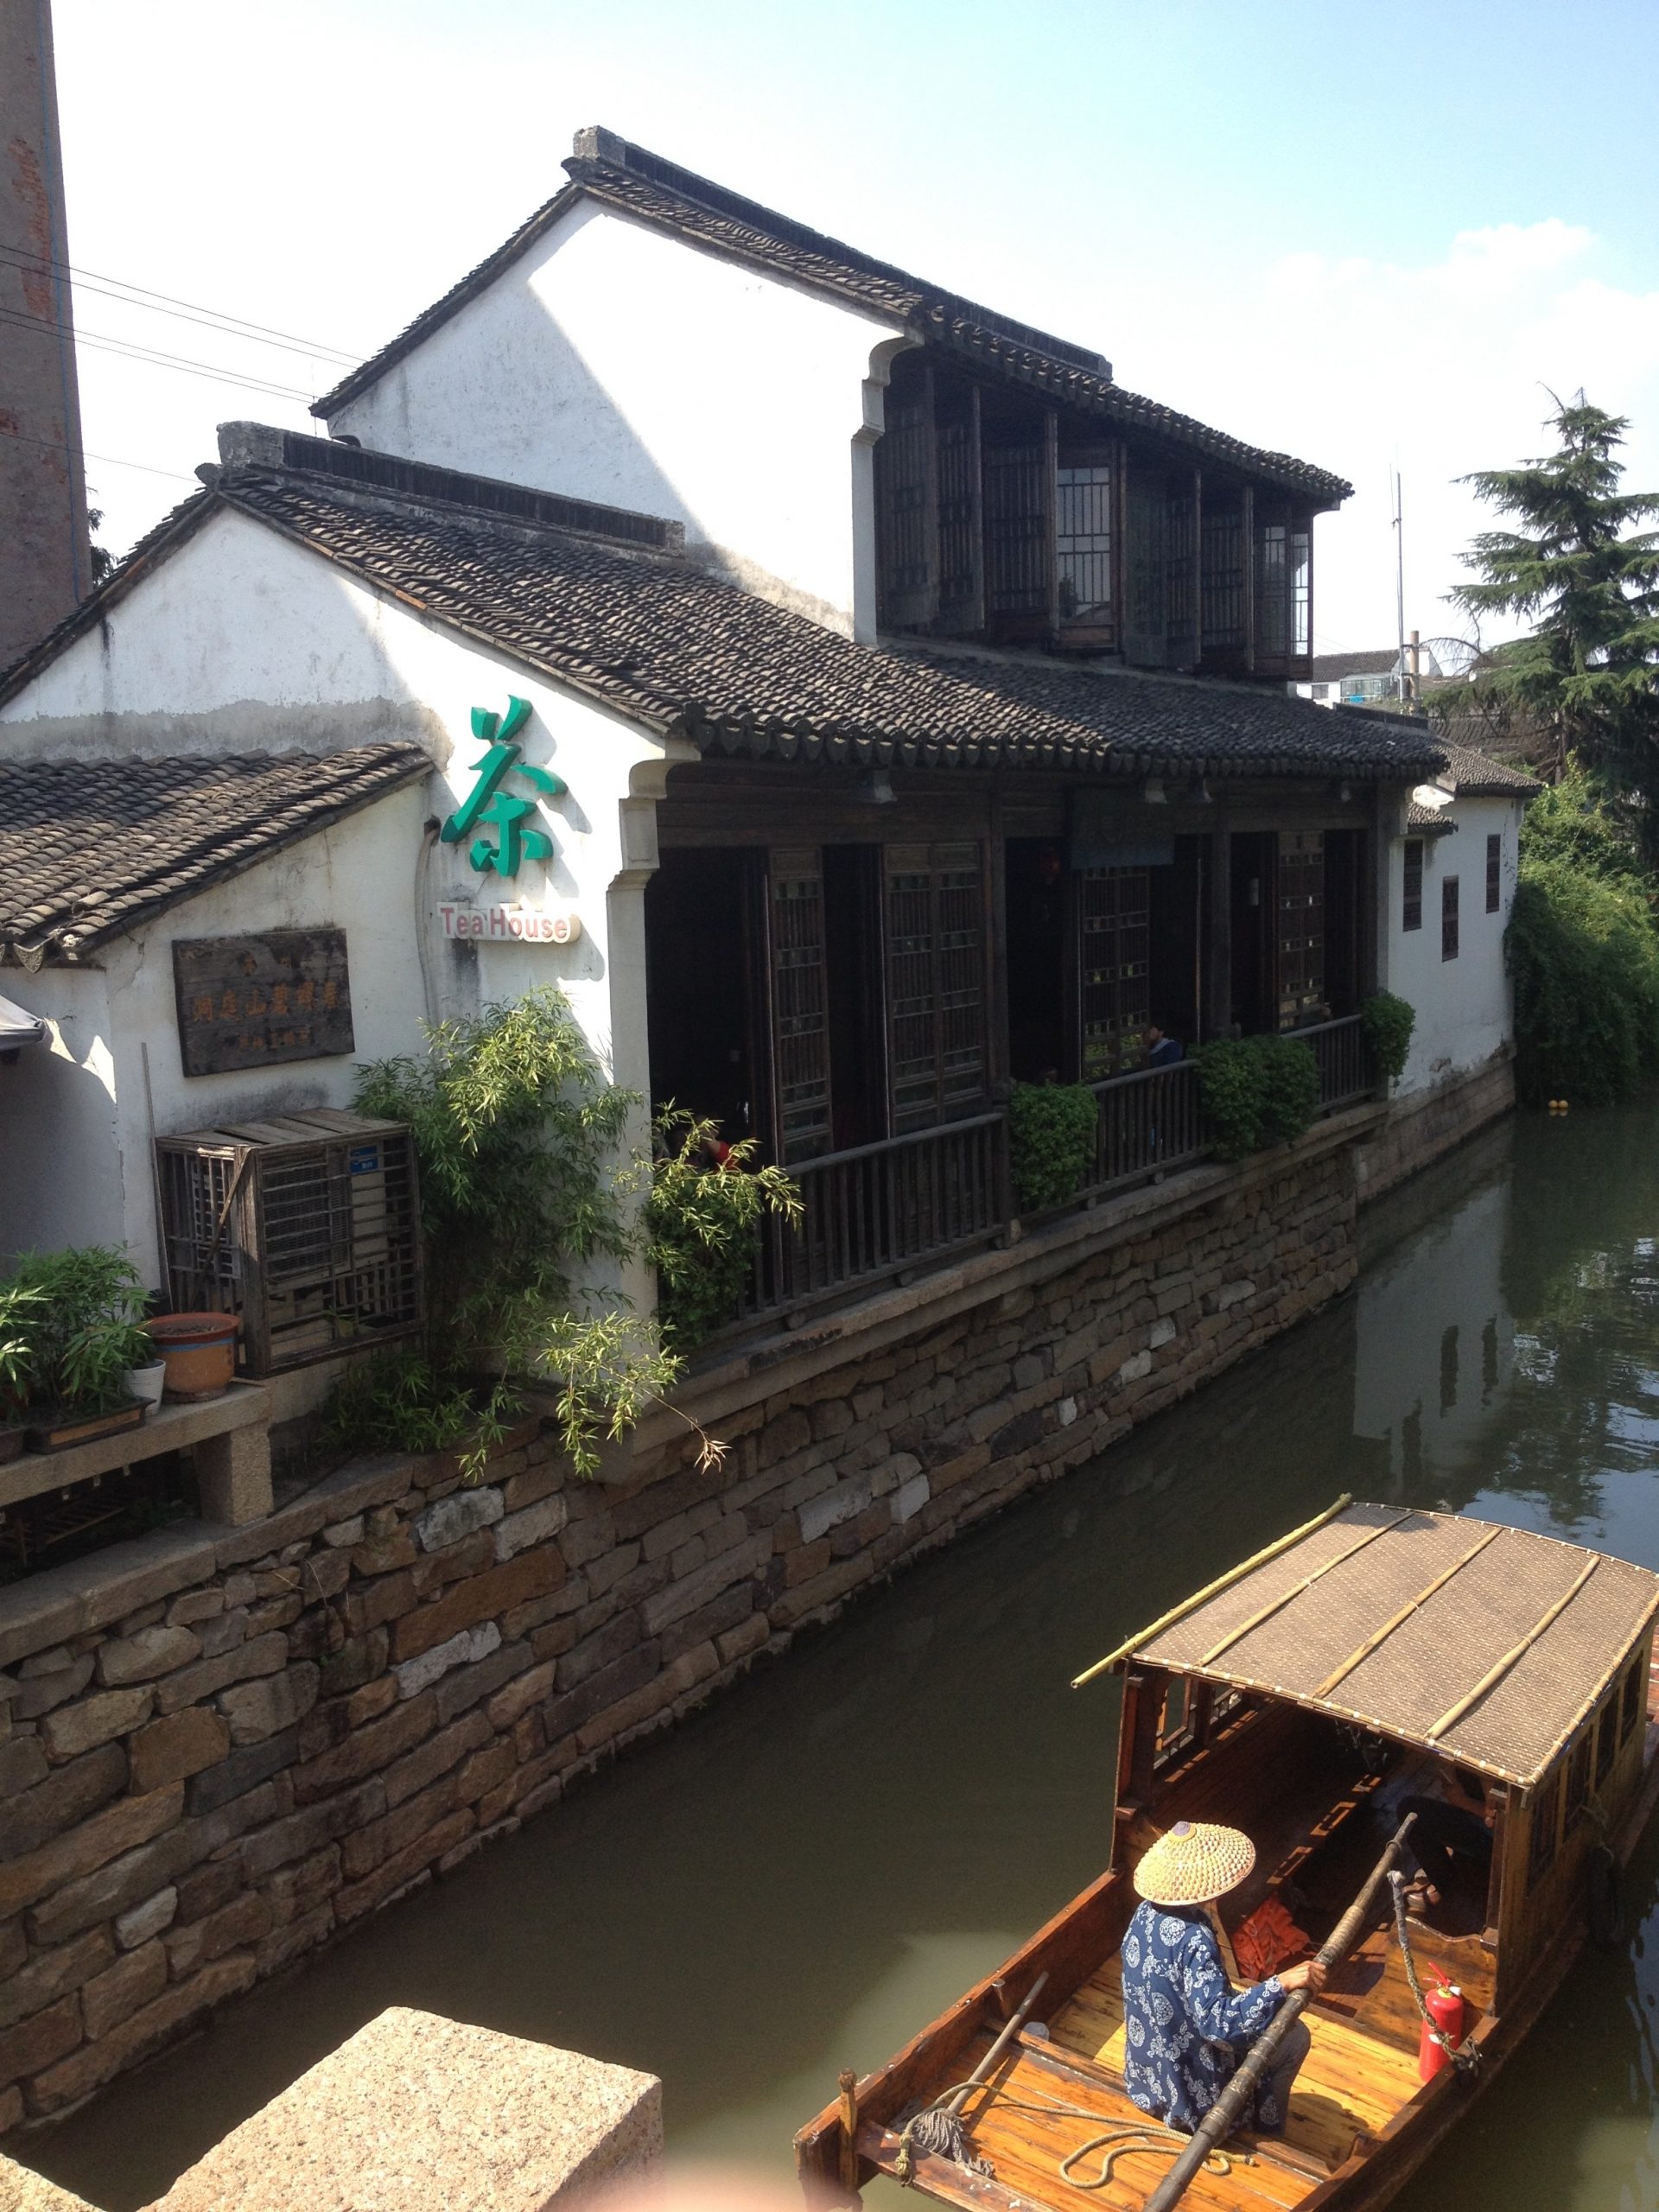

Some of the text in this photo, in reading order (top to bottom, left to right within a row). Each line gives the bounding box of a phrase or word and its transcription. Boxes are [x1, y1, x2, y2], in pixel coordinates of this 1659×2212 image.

[441, 694, 568, 878] 茶
[440, 907, 569, 939] Tea House
